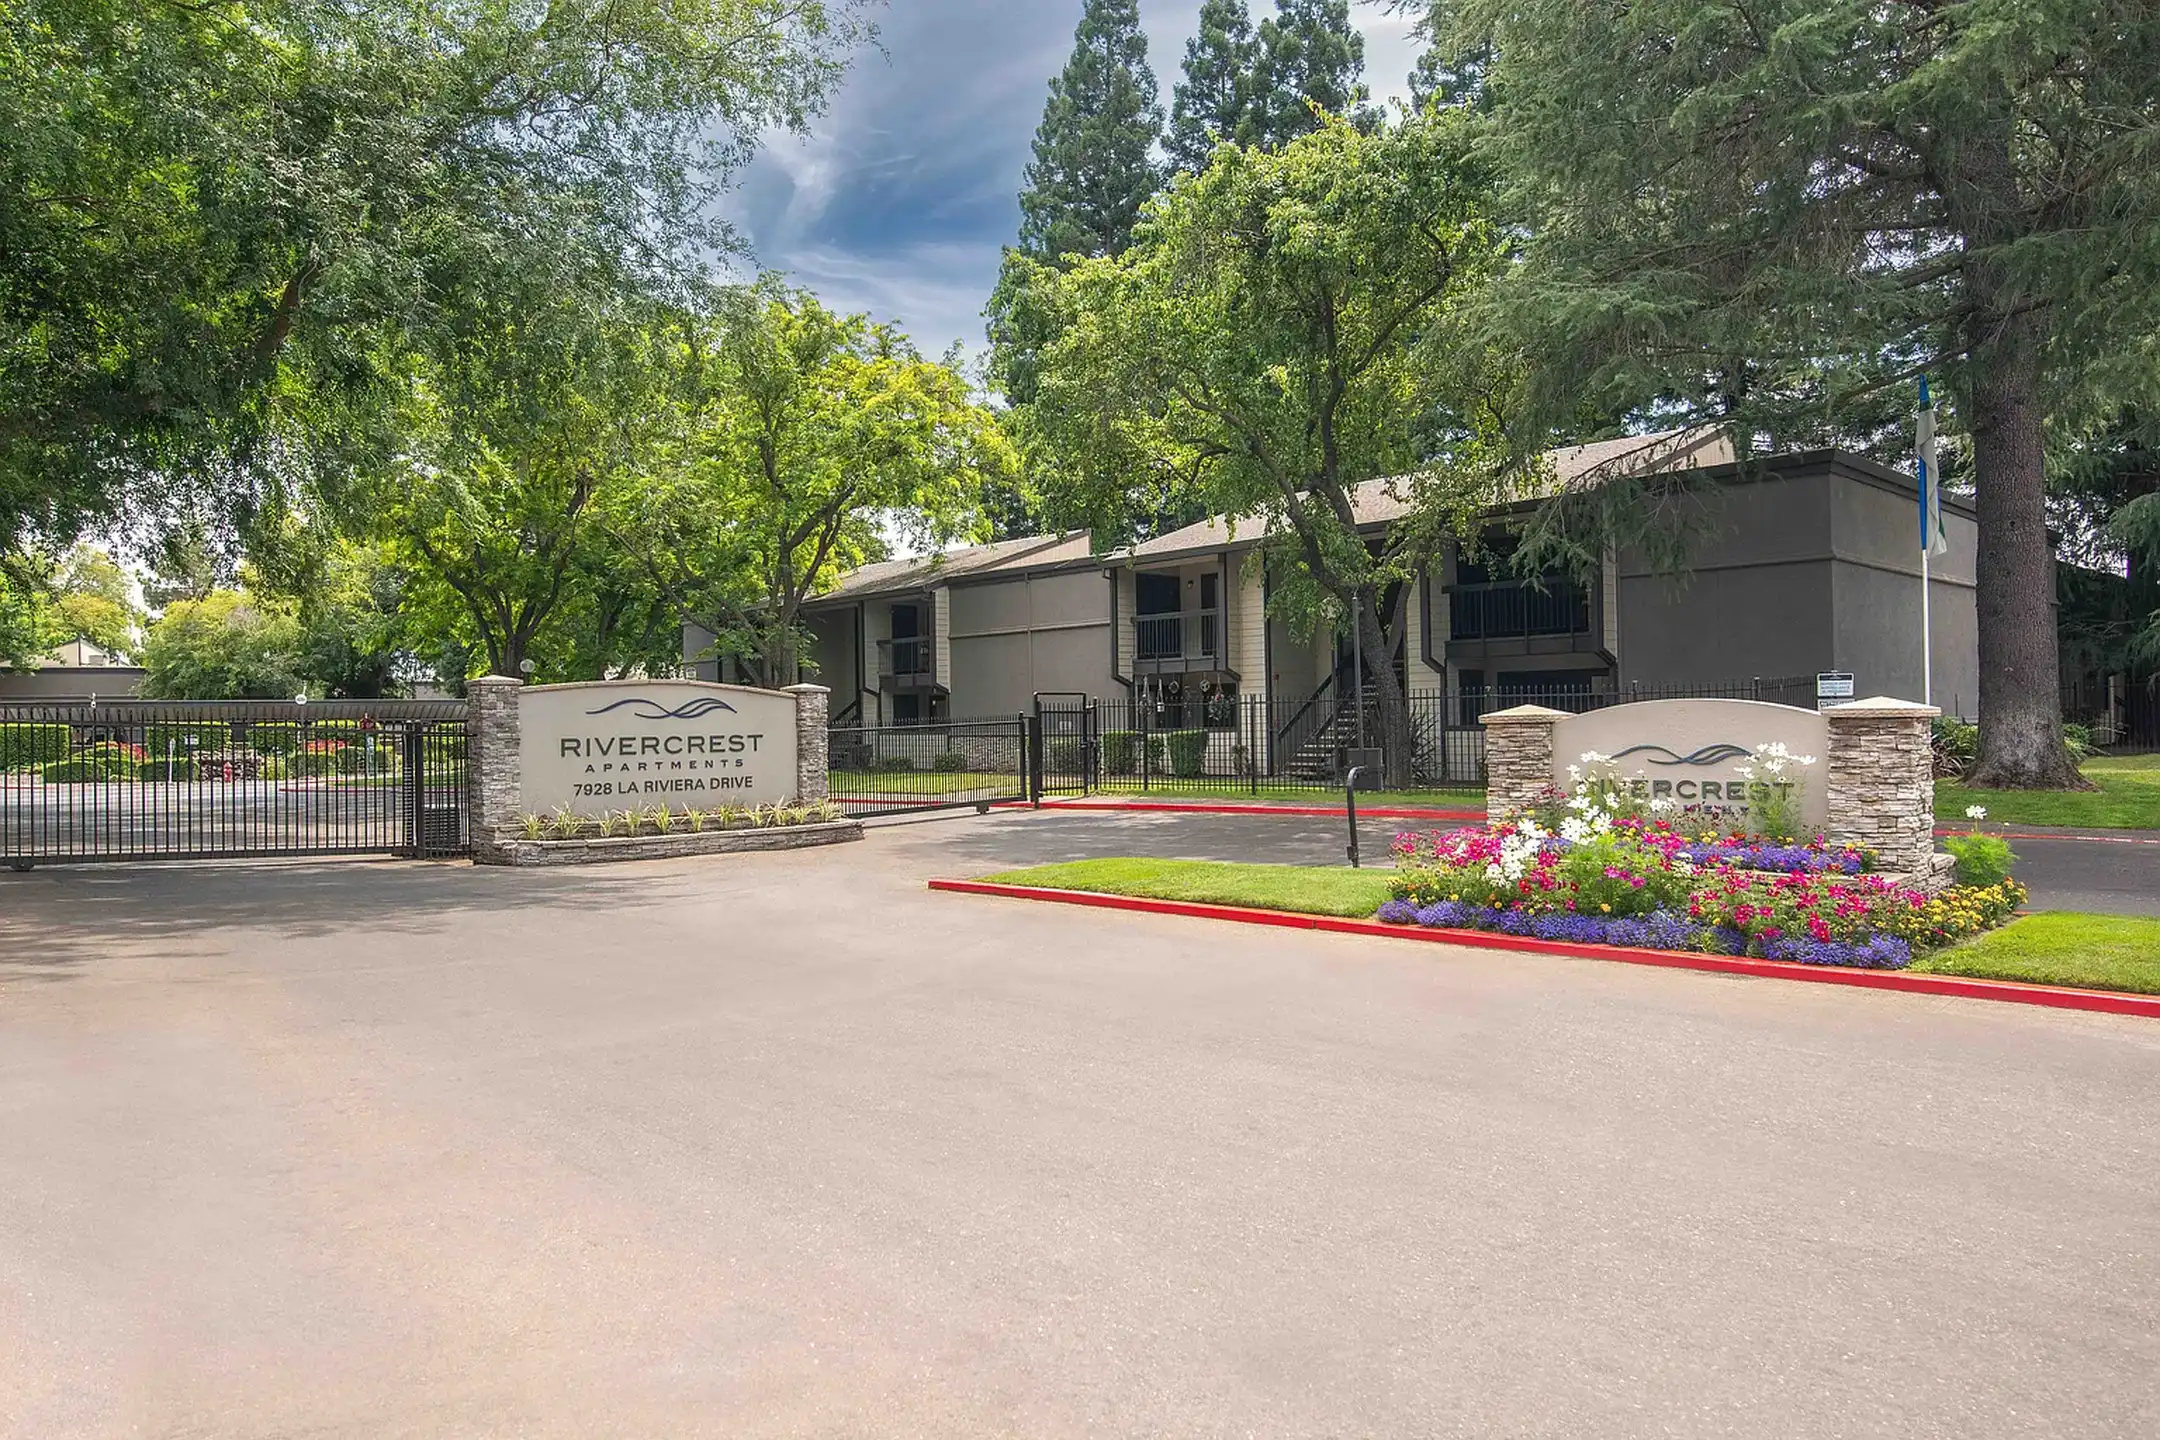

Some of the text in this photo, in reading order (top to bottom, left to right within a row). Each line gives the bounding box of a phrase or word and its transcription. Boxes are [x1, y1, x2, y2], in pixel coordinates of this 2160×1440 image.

[560, 734, 764, 758] RIVERCREST
[584, 758, 744, 774] APARTMENTS
[573, 775, 754, 797] 7928 LA RIVIERA DRIVE
